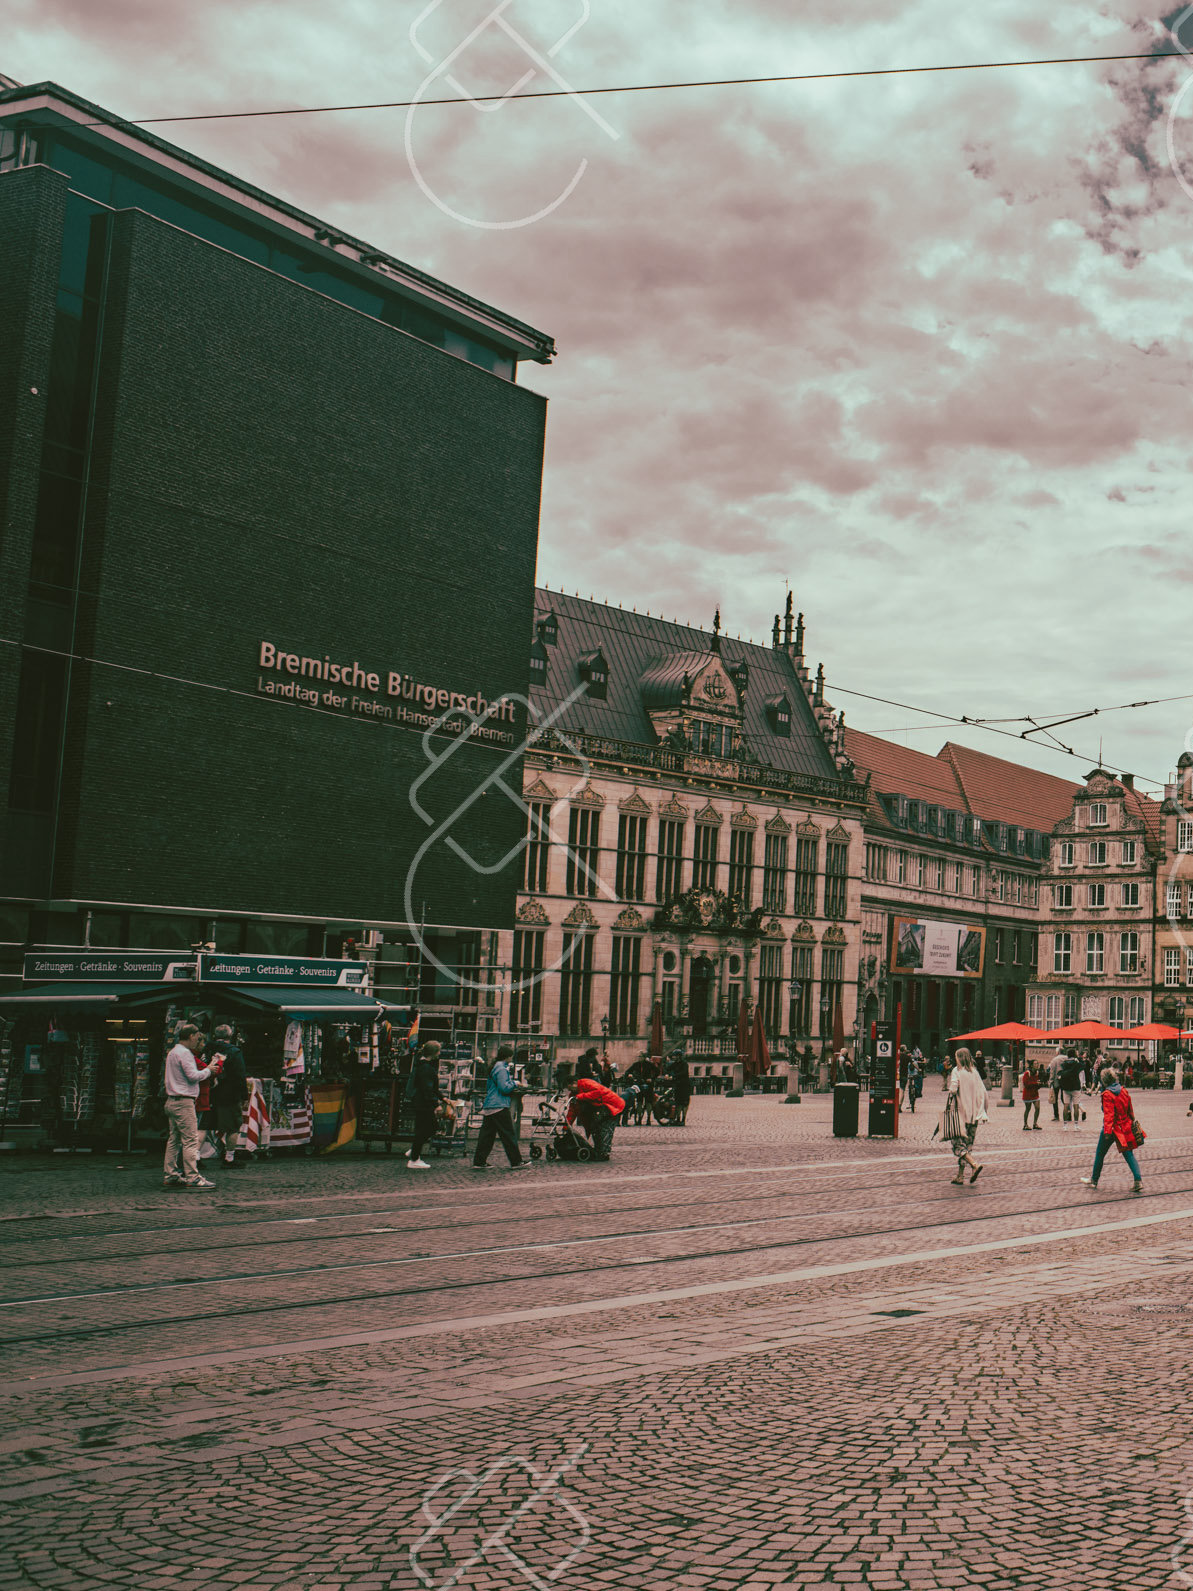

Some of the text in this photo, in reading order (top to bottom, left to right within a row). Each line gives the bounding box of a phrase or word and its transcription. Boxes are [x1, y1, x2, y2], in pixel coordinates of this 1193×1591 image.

[259, 641, 516, 723] Bremische Bürgerschaft
[257, 676, 515, 744] Landtag der Freien Hansestadt Bremen
[34, 961, 163, 973] Zeitungen Getränke Souvenirs
[256, 964, 294, 975] Getränke
[299, 965, 337, 977] Souvenirs
